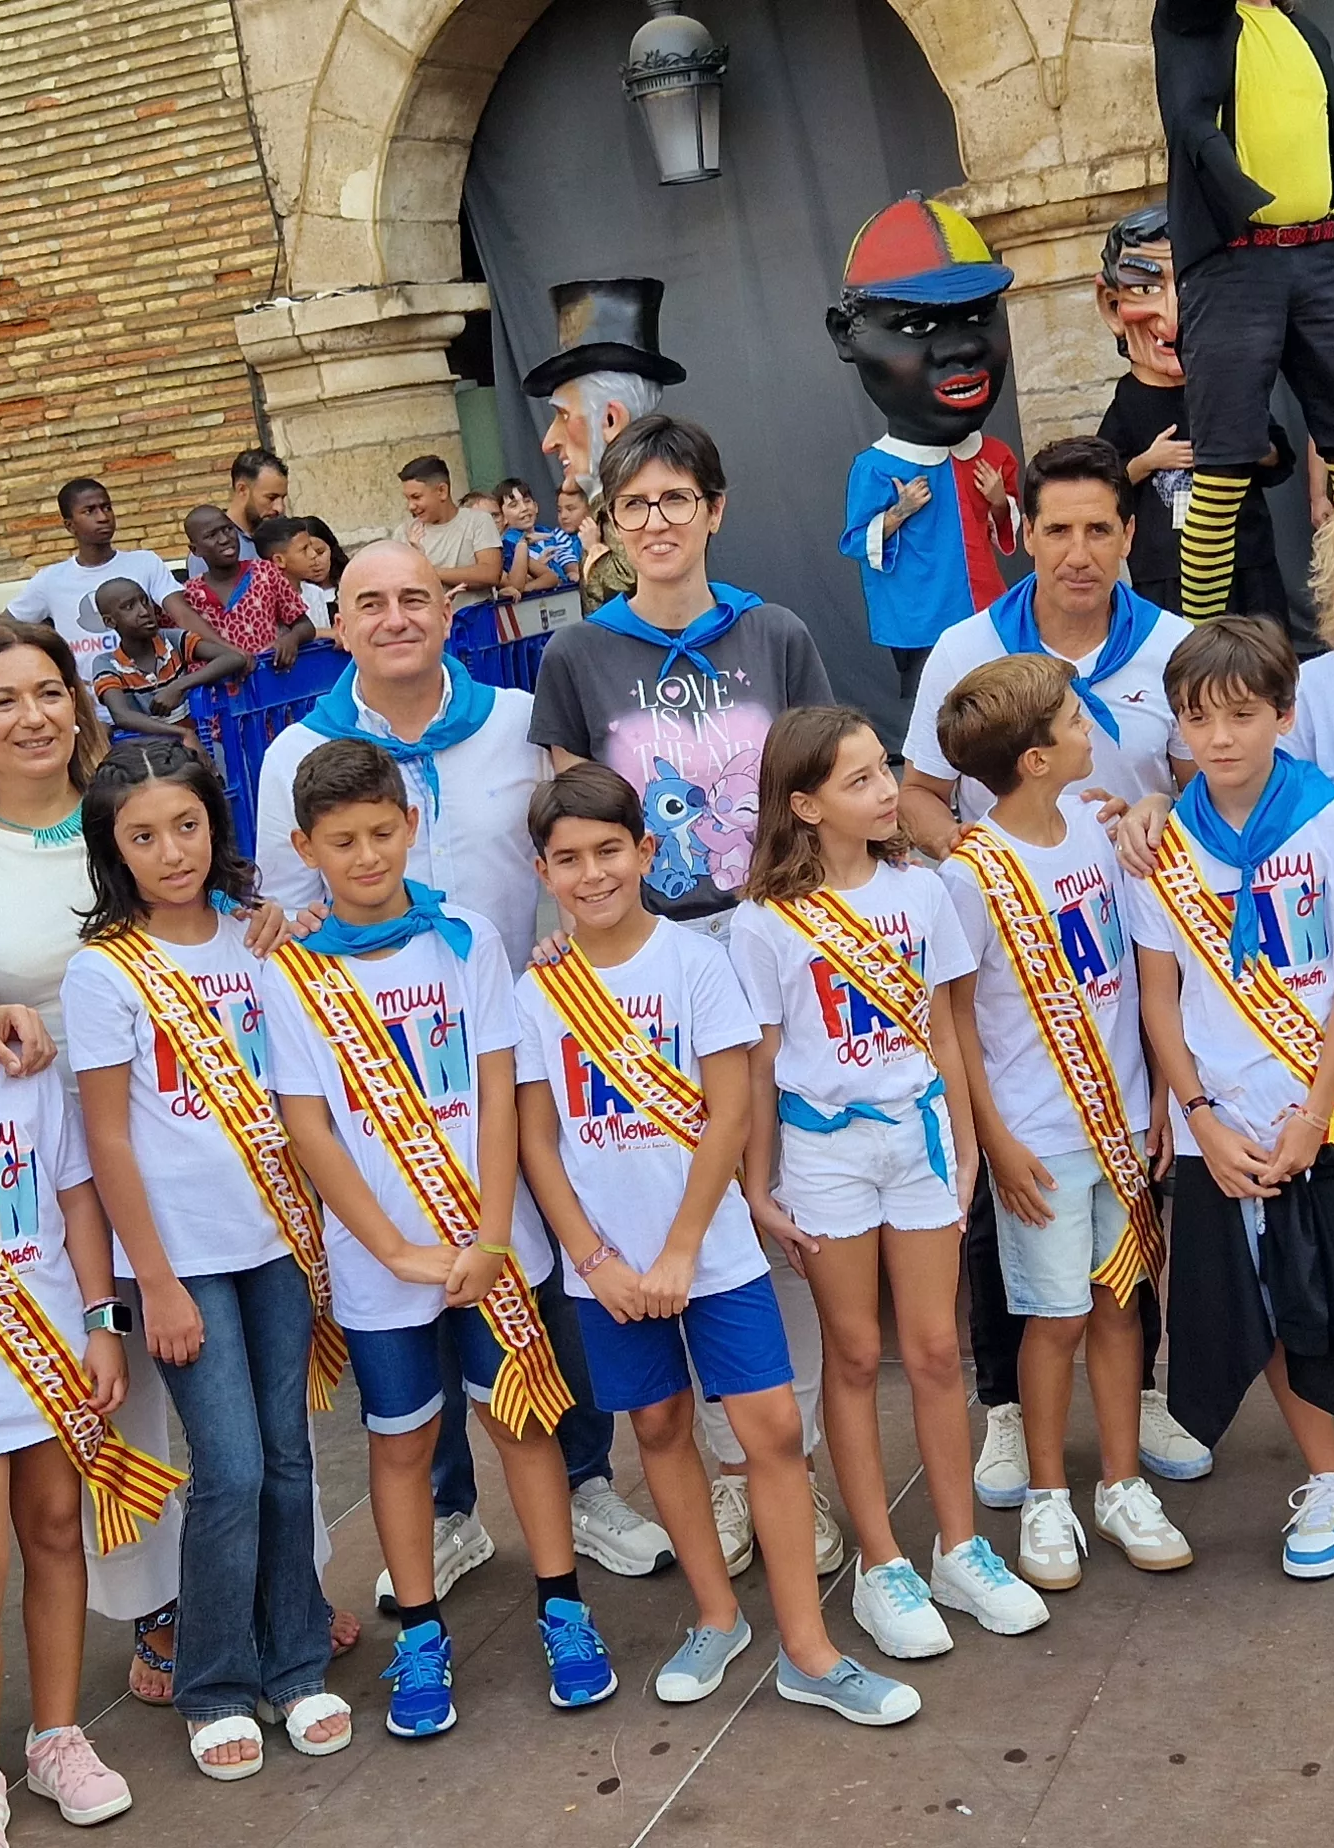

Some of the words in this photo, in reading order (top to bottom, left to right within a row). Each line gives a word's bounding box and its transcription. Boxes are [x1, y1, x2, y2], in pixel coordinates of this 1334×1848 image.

[637, 670, 735, 710] LOVE
[650, 708, 681, 741] IS
[692, 710, 731, 745] IN
[633, 740, 698, 781] THE
[191, 971, 264, 1033] muy
[375, 981, 457, 1047] muy
[837, 1017, 874, 1068] de
[131, 950, 243, 1108] Zagaleta
[241, 1103, 313, 1251] Monzón
[171, 1070, 212, 1121] de
[1036, 976, 1105, 1123] Monzón
[1100, 1127, 1148, 1200] 2025
[308, 968, 408, 1125] Zagalete
[487, 1276, 541, 1349] 2025
